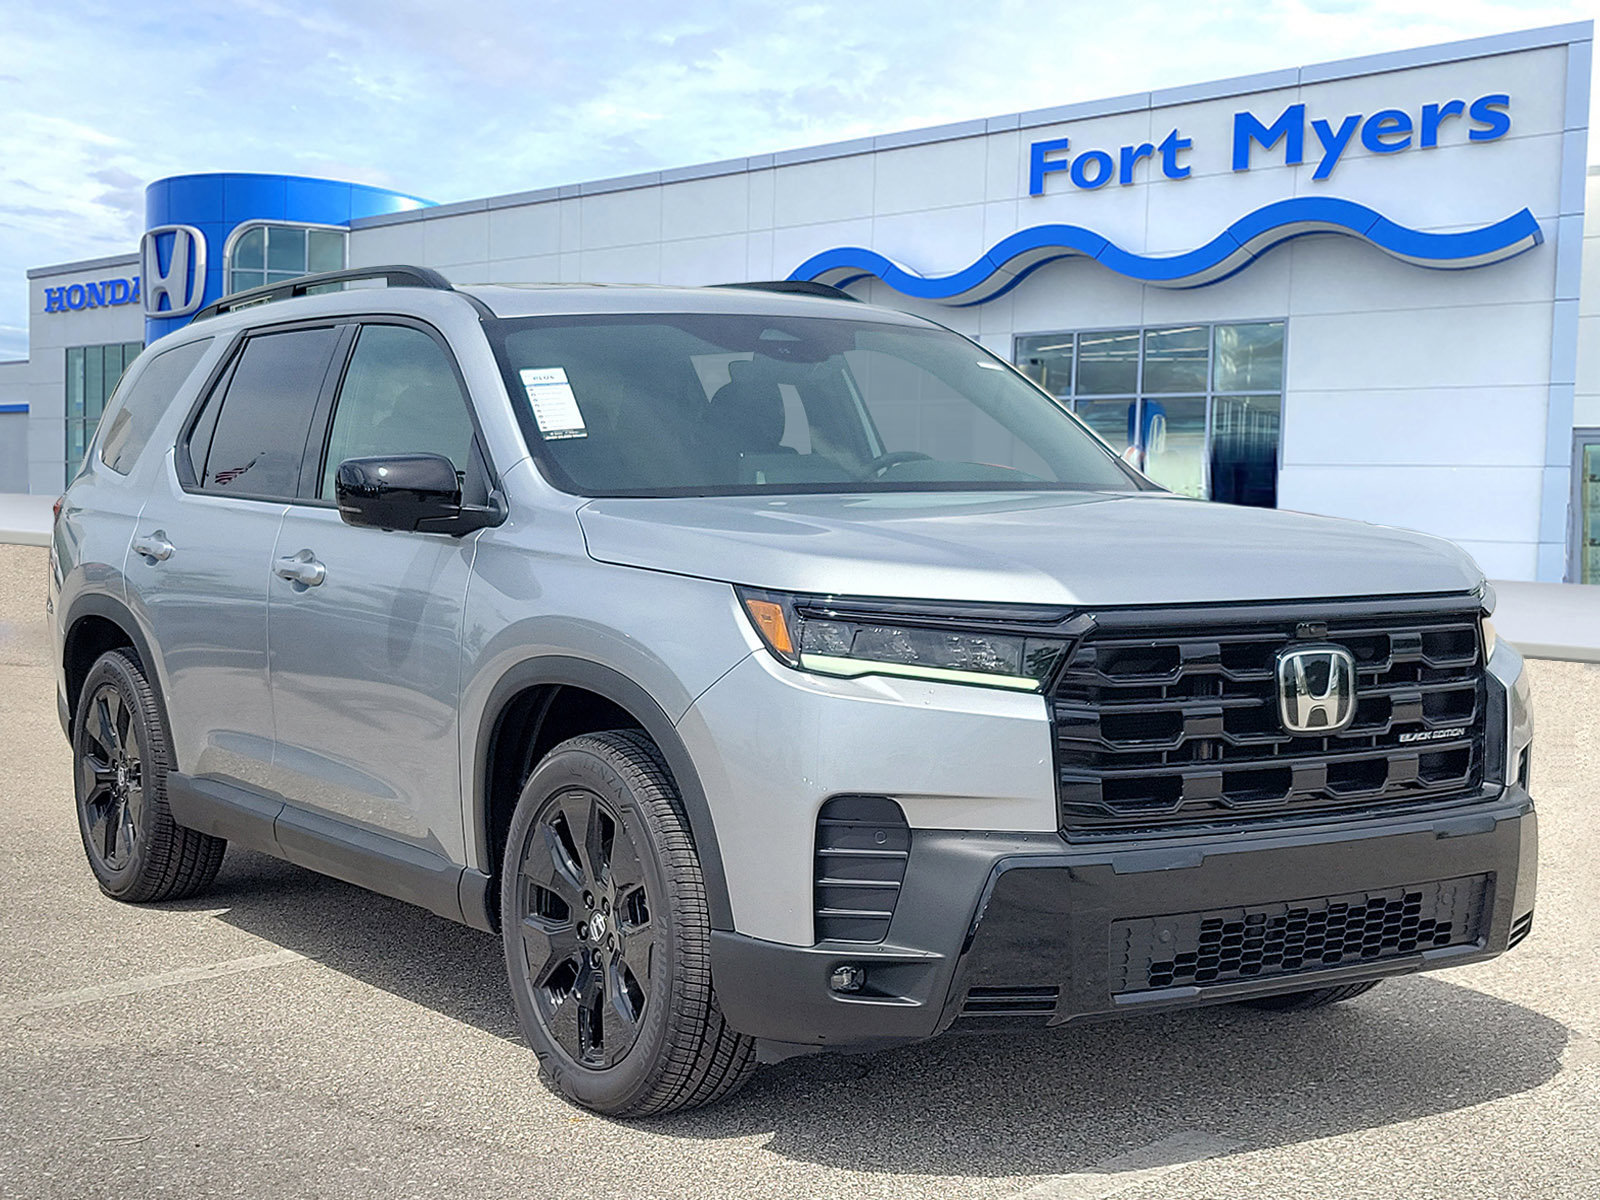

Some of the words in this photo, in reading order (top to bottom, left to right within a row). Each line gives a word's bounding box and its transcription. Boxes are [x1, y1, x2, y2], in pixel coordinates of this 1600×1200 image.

[1029, 127, 1193, 197] Fort
[1232, 93, 1513, 182] Myers
[1399, 731, 1432, 742] BLACK
[1432, 728, 1465, 739] EDITION
